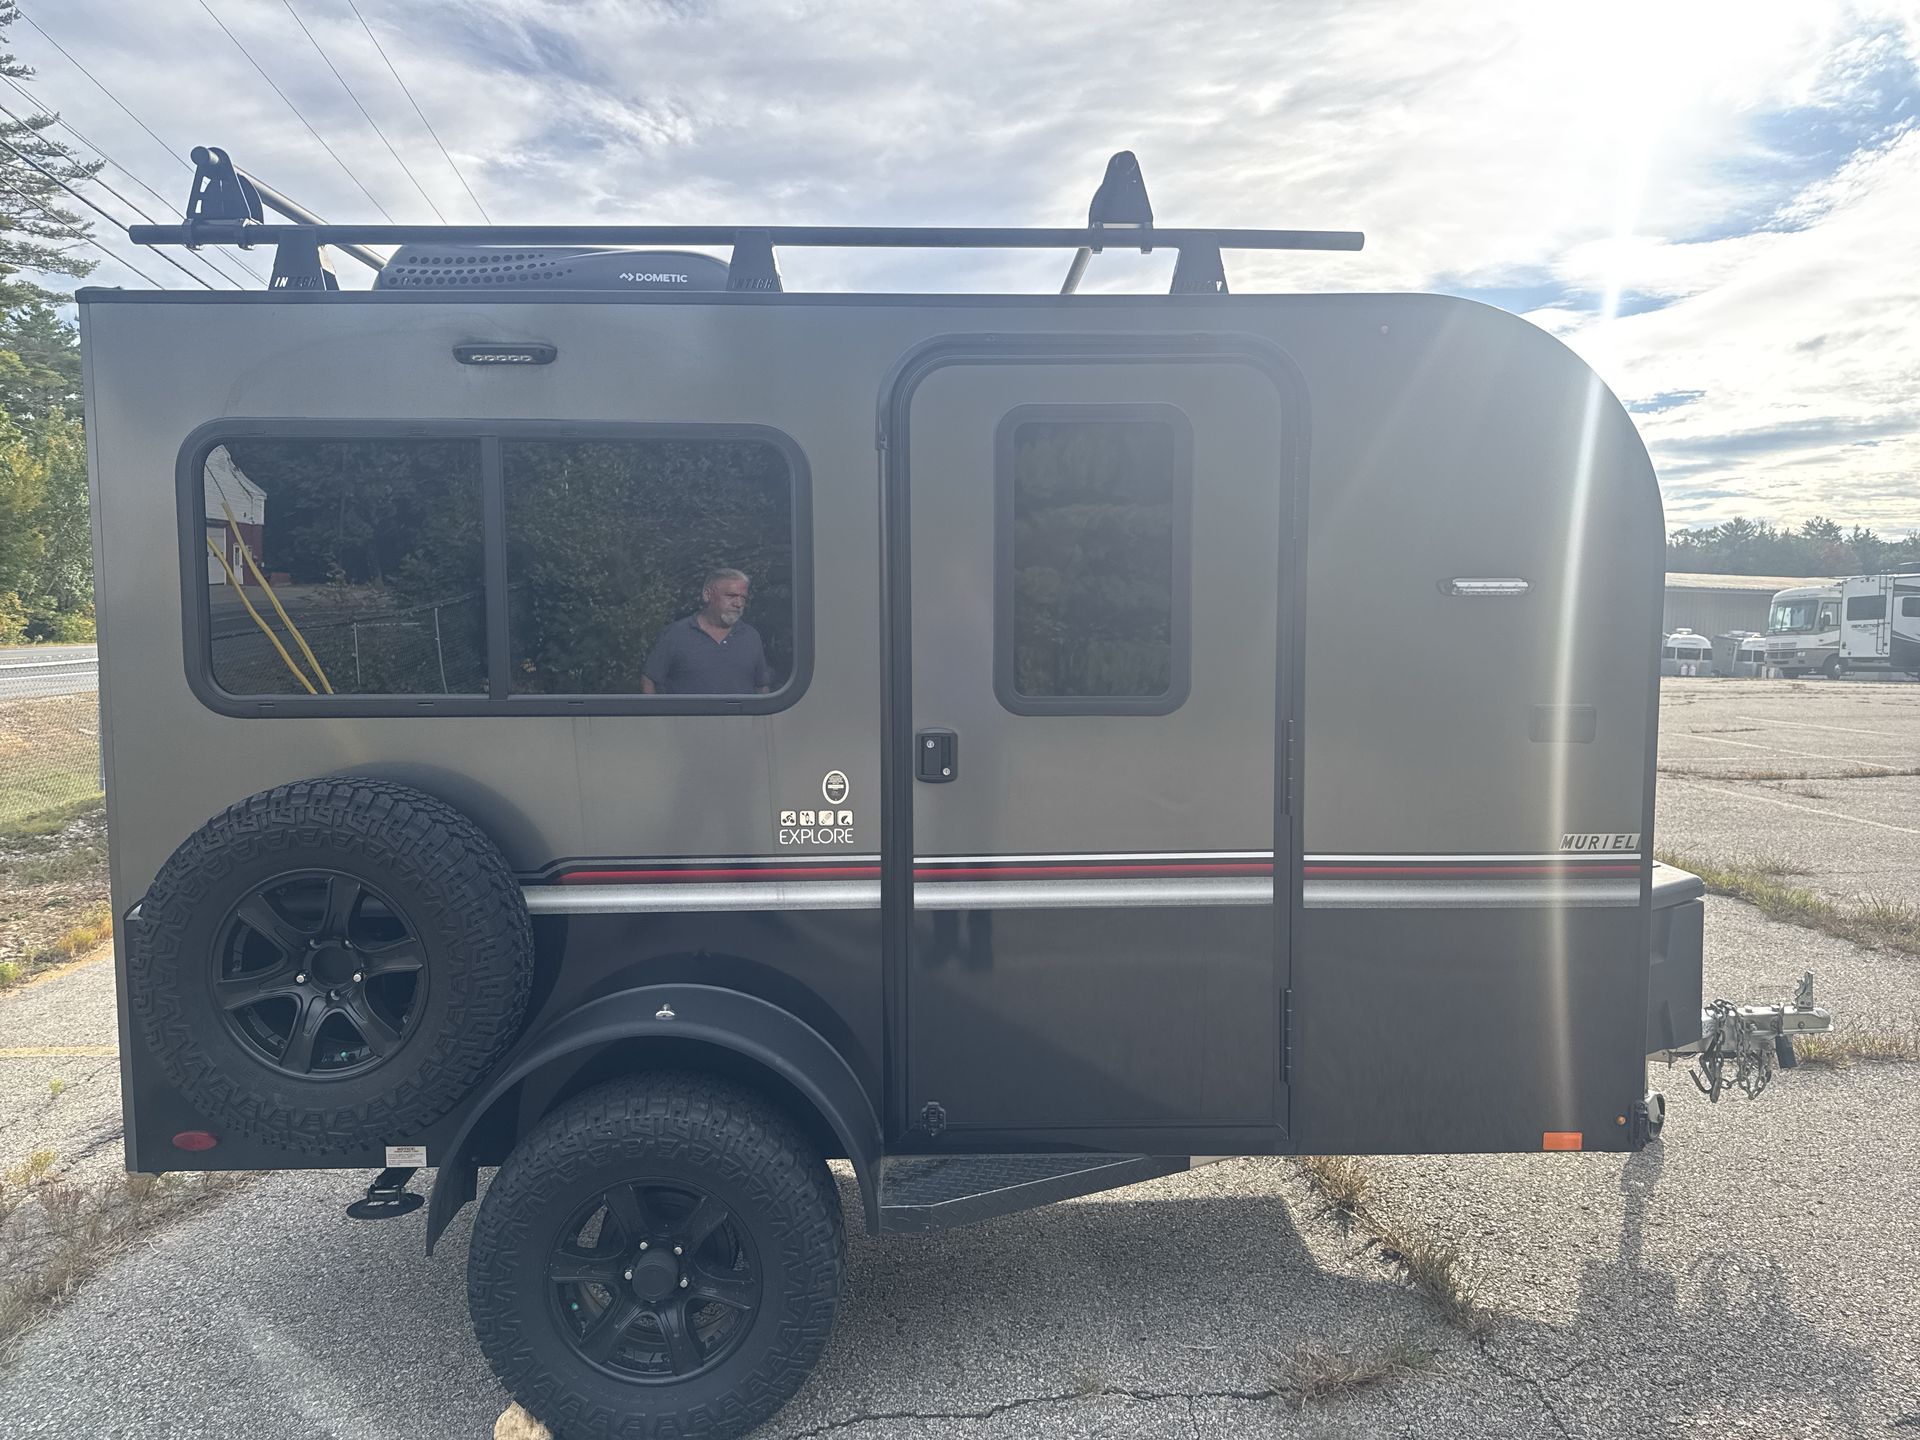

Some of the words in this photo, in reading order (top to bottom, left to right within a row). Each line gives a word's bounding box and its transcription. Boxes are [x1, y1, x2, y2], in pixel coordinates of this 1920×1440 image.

[635, 272, 688, 283] DOMETIC
[779, 828, 854, 845] EXPLORE
[1560, 835, 1635, 850] MURIEL
